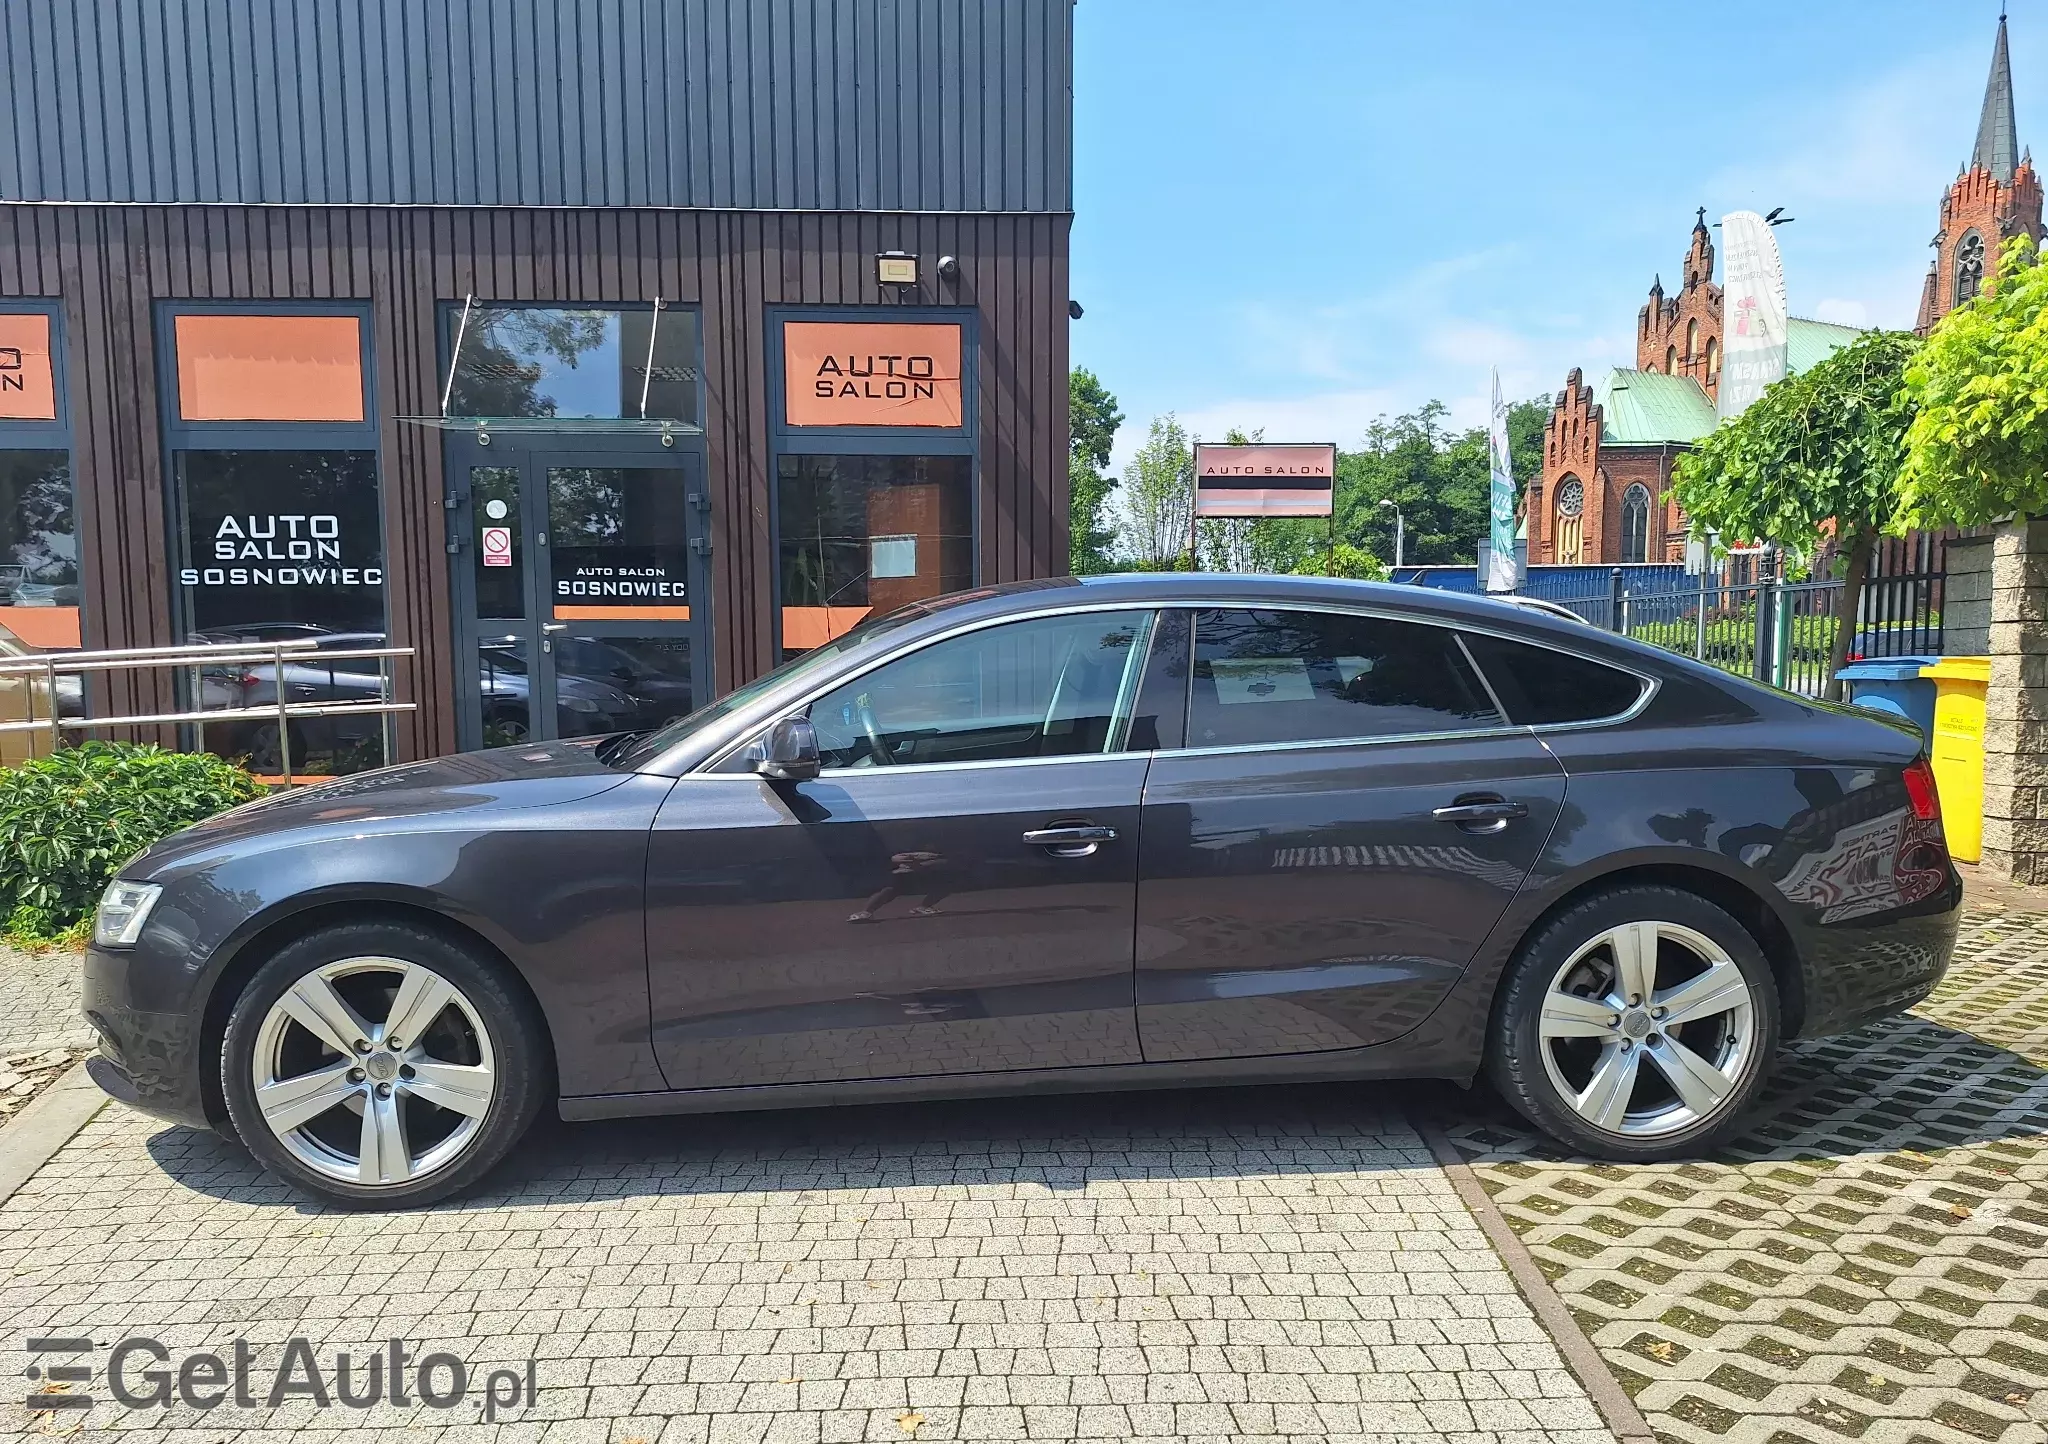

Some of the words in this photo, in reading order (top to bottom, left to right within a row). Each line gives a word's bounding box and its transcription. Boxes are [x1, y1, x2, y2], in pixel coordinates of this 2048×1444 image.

[816, 355, 933, 378] AUTO
[815, 380, 934, 399] SALON
[1206, 466, 1254, 474] AUTO
[1264, 466, 1324, 474] SALON
[215, 515, 339, 539] AUTO
[215, 540, 340, 560] SALON
[180, 568, 383, 585] SOSNOWIEC
[576, 567, 613, 576] AUTO
[618, 568, 665, 577] SALON
[557, 580, 685, 597] SOSNOWIEC
